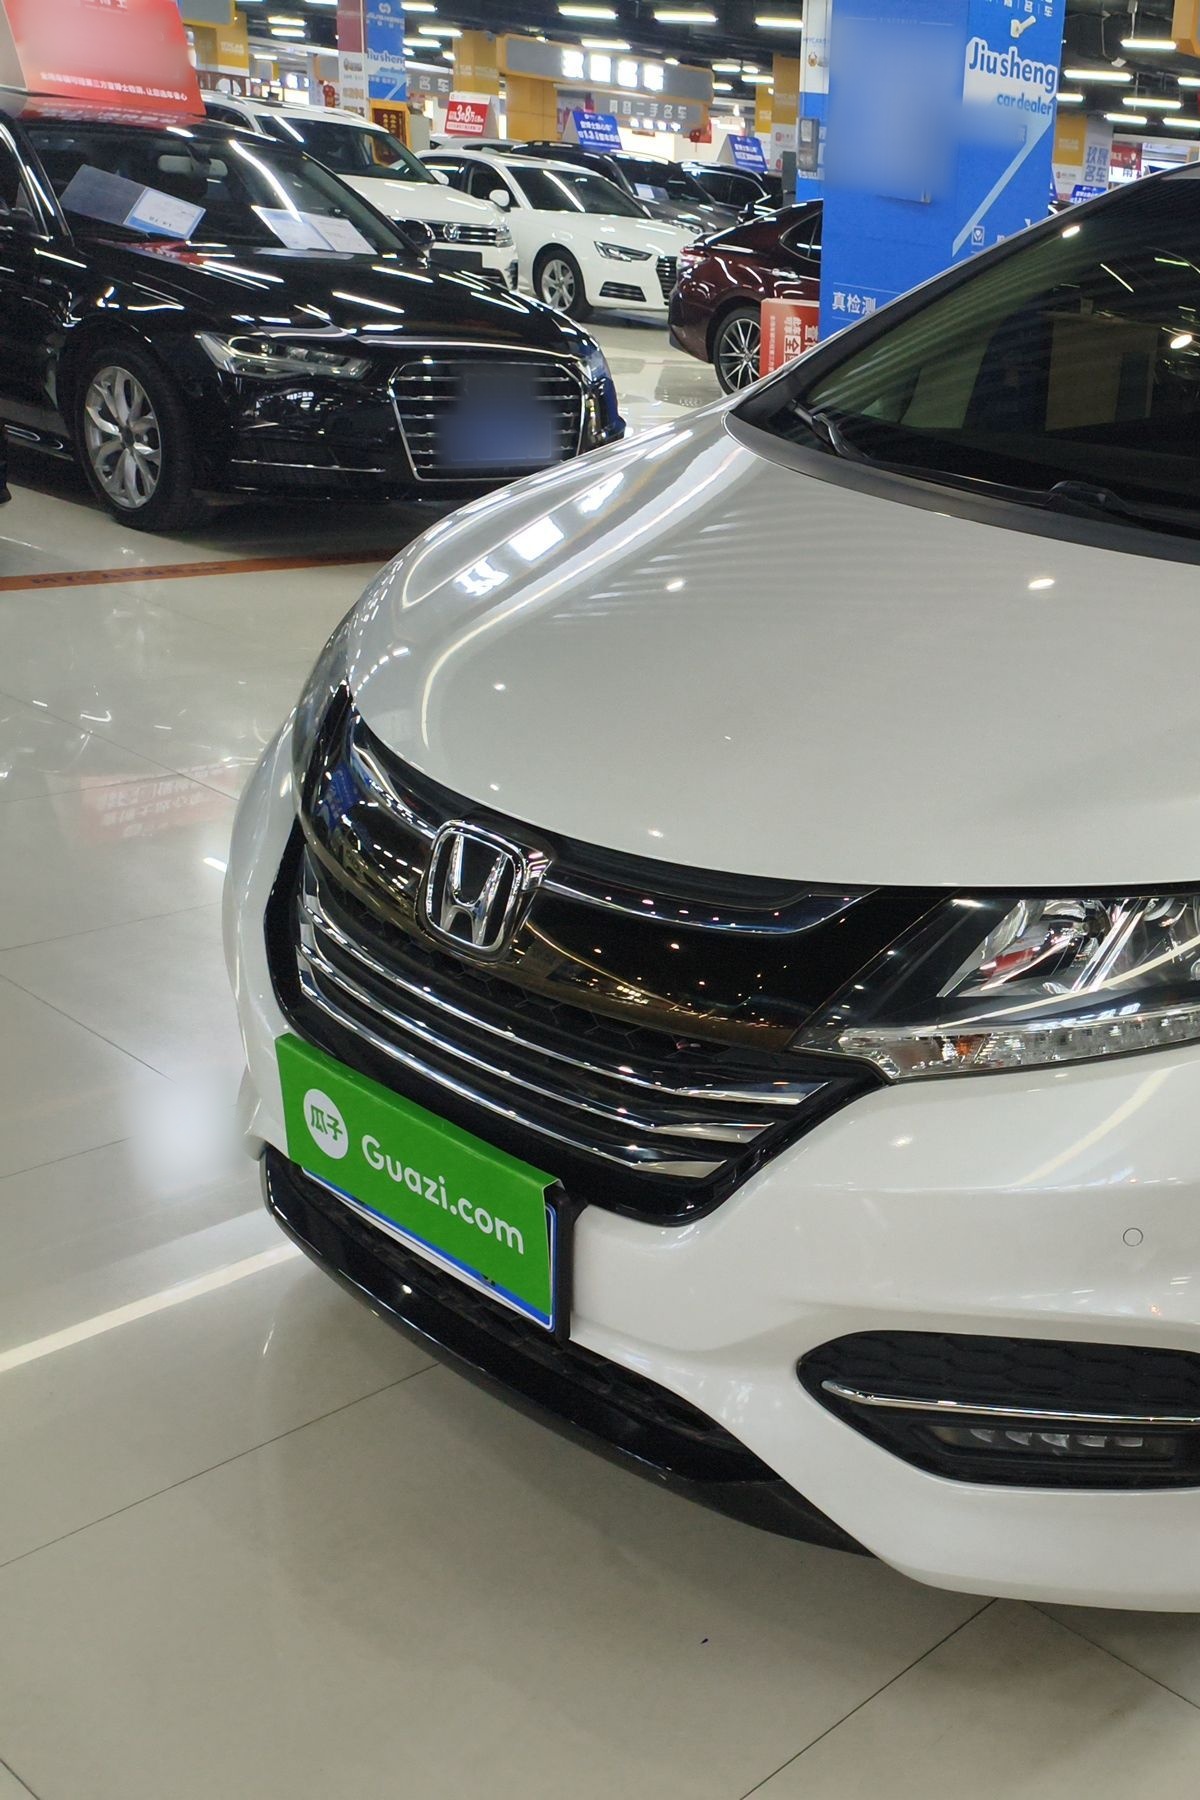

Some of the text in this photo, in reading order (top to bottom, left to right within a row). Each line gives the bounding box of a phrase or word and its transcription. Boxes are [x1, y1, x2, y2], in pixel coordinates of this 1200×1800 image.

[968, 41, 1056, 94] Jiusheng
[997, 93, 1052, 116] car dealer
[832, 291, 877, 316] 真检测
[310, 1104, 343, 1141] 瓜子
[361, 1134, 525, 1255] Guazi.com
